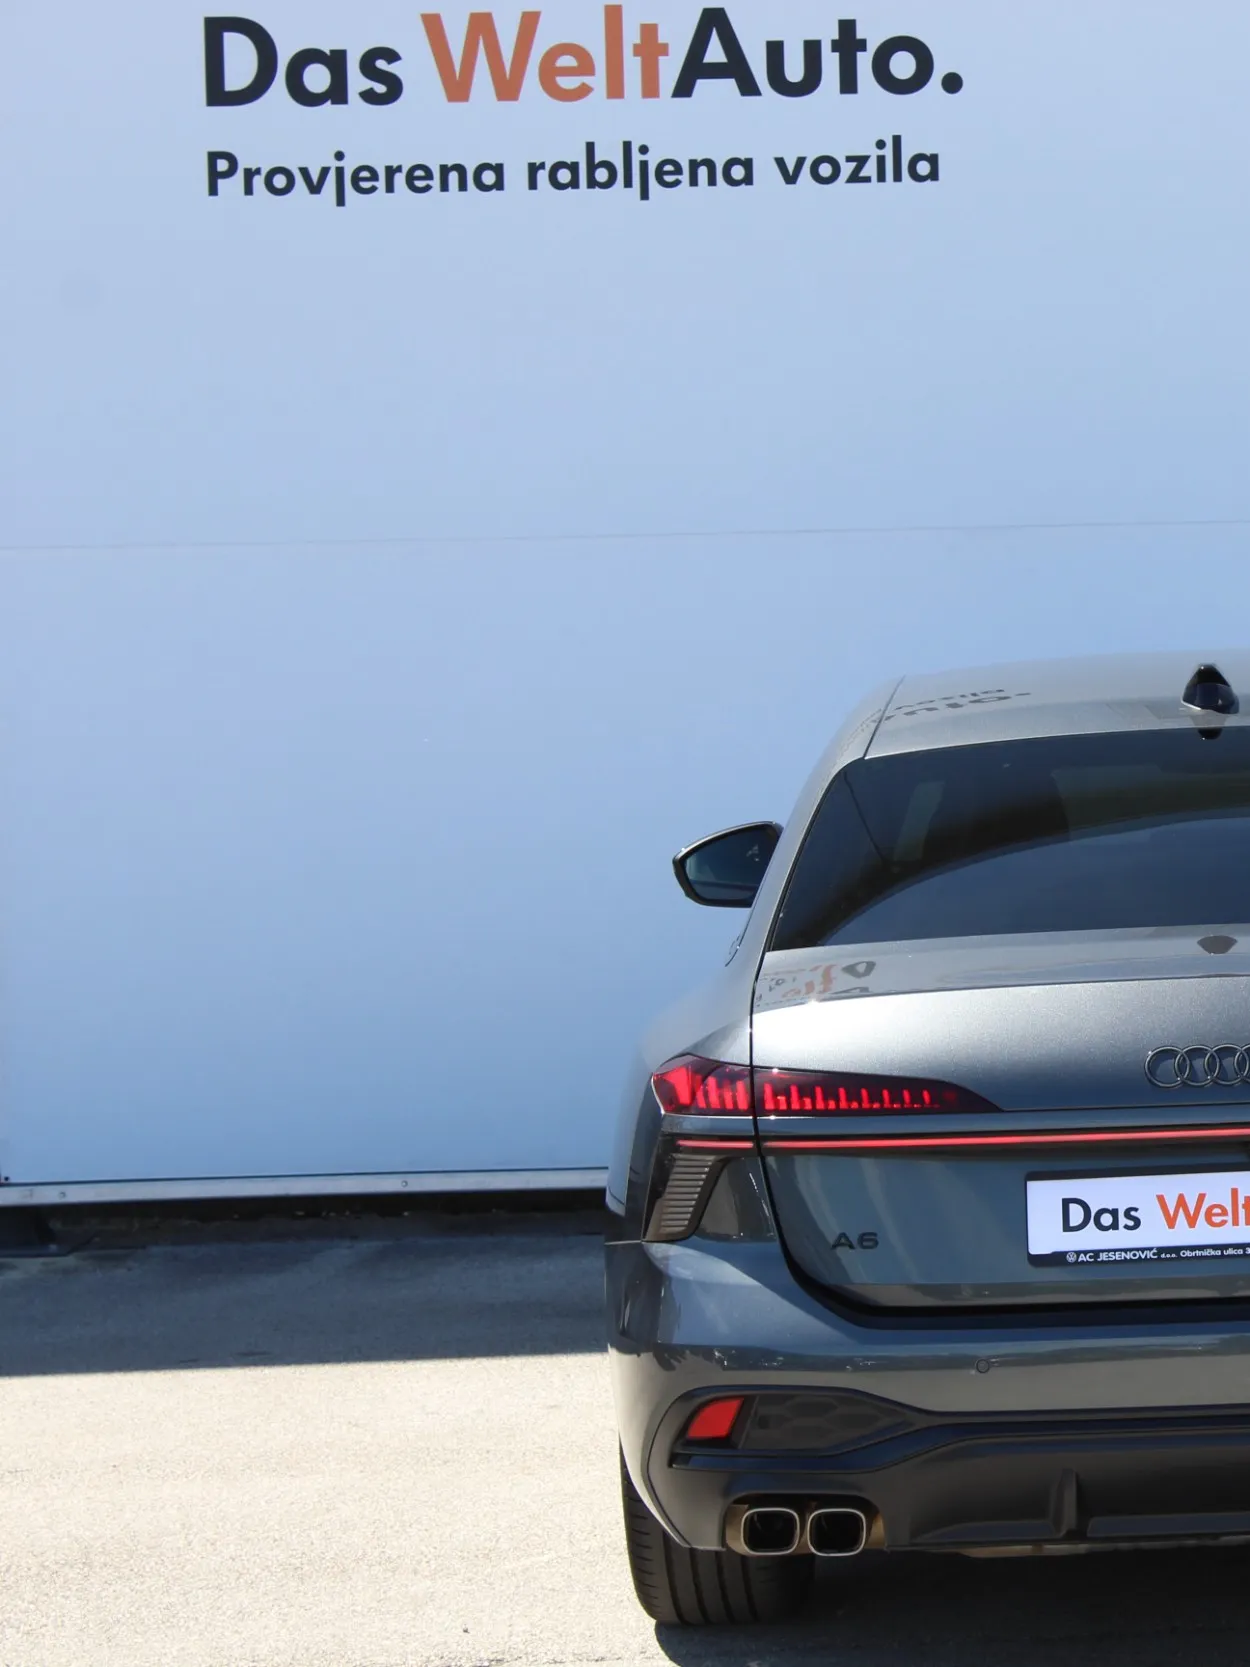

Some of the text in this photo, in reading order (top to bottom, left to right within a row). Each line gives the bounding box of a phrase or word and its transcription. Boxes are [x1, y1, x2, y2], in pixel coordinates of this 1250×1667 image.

[203, 4, 964, 108] Das WeltAuto.
[206, 134, 940, 207] Provjerena rabljena vozila
[1061, 1197, 1142, 1233] Das
[831, 1232, 879, 1250] A6
[1078, 1252, 1095, 1262] AC
[1097, 1248, 1158, 1262] JESENOVIĆ
[1180, 1248, 1221, 1257] Obrtnička
[1223, 1247, 1243, 1255] ulica
